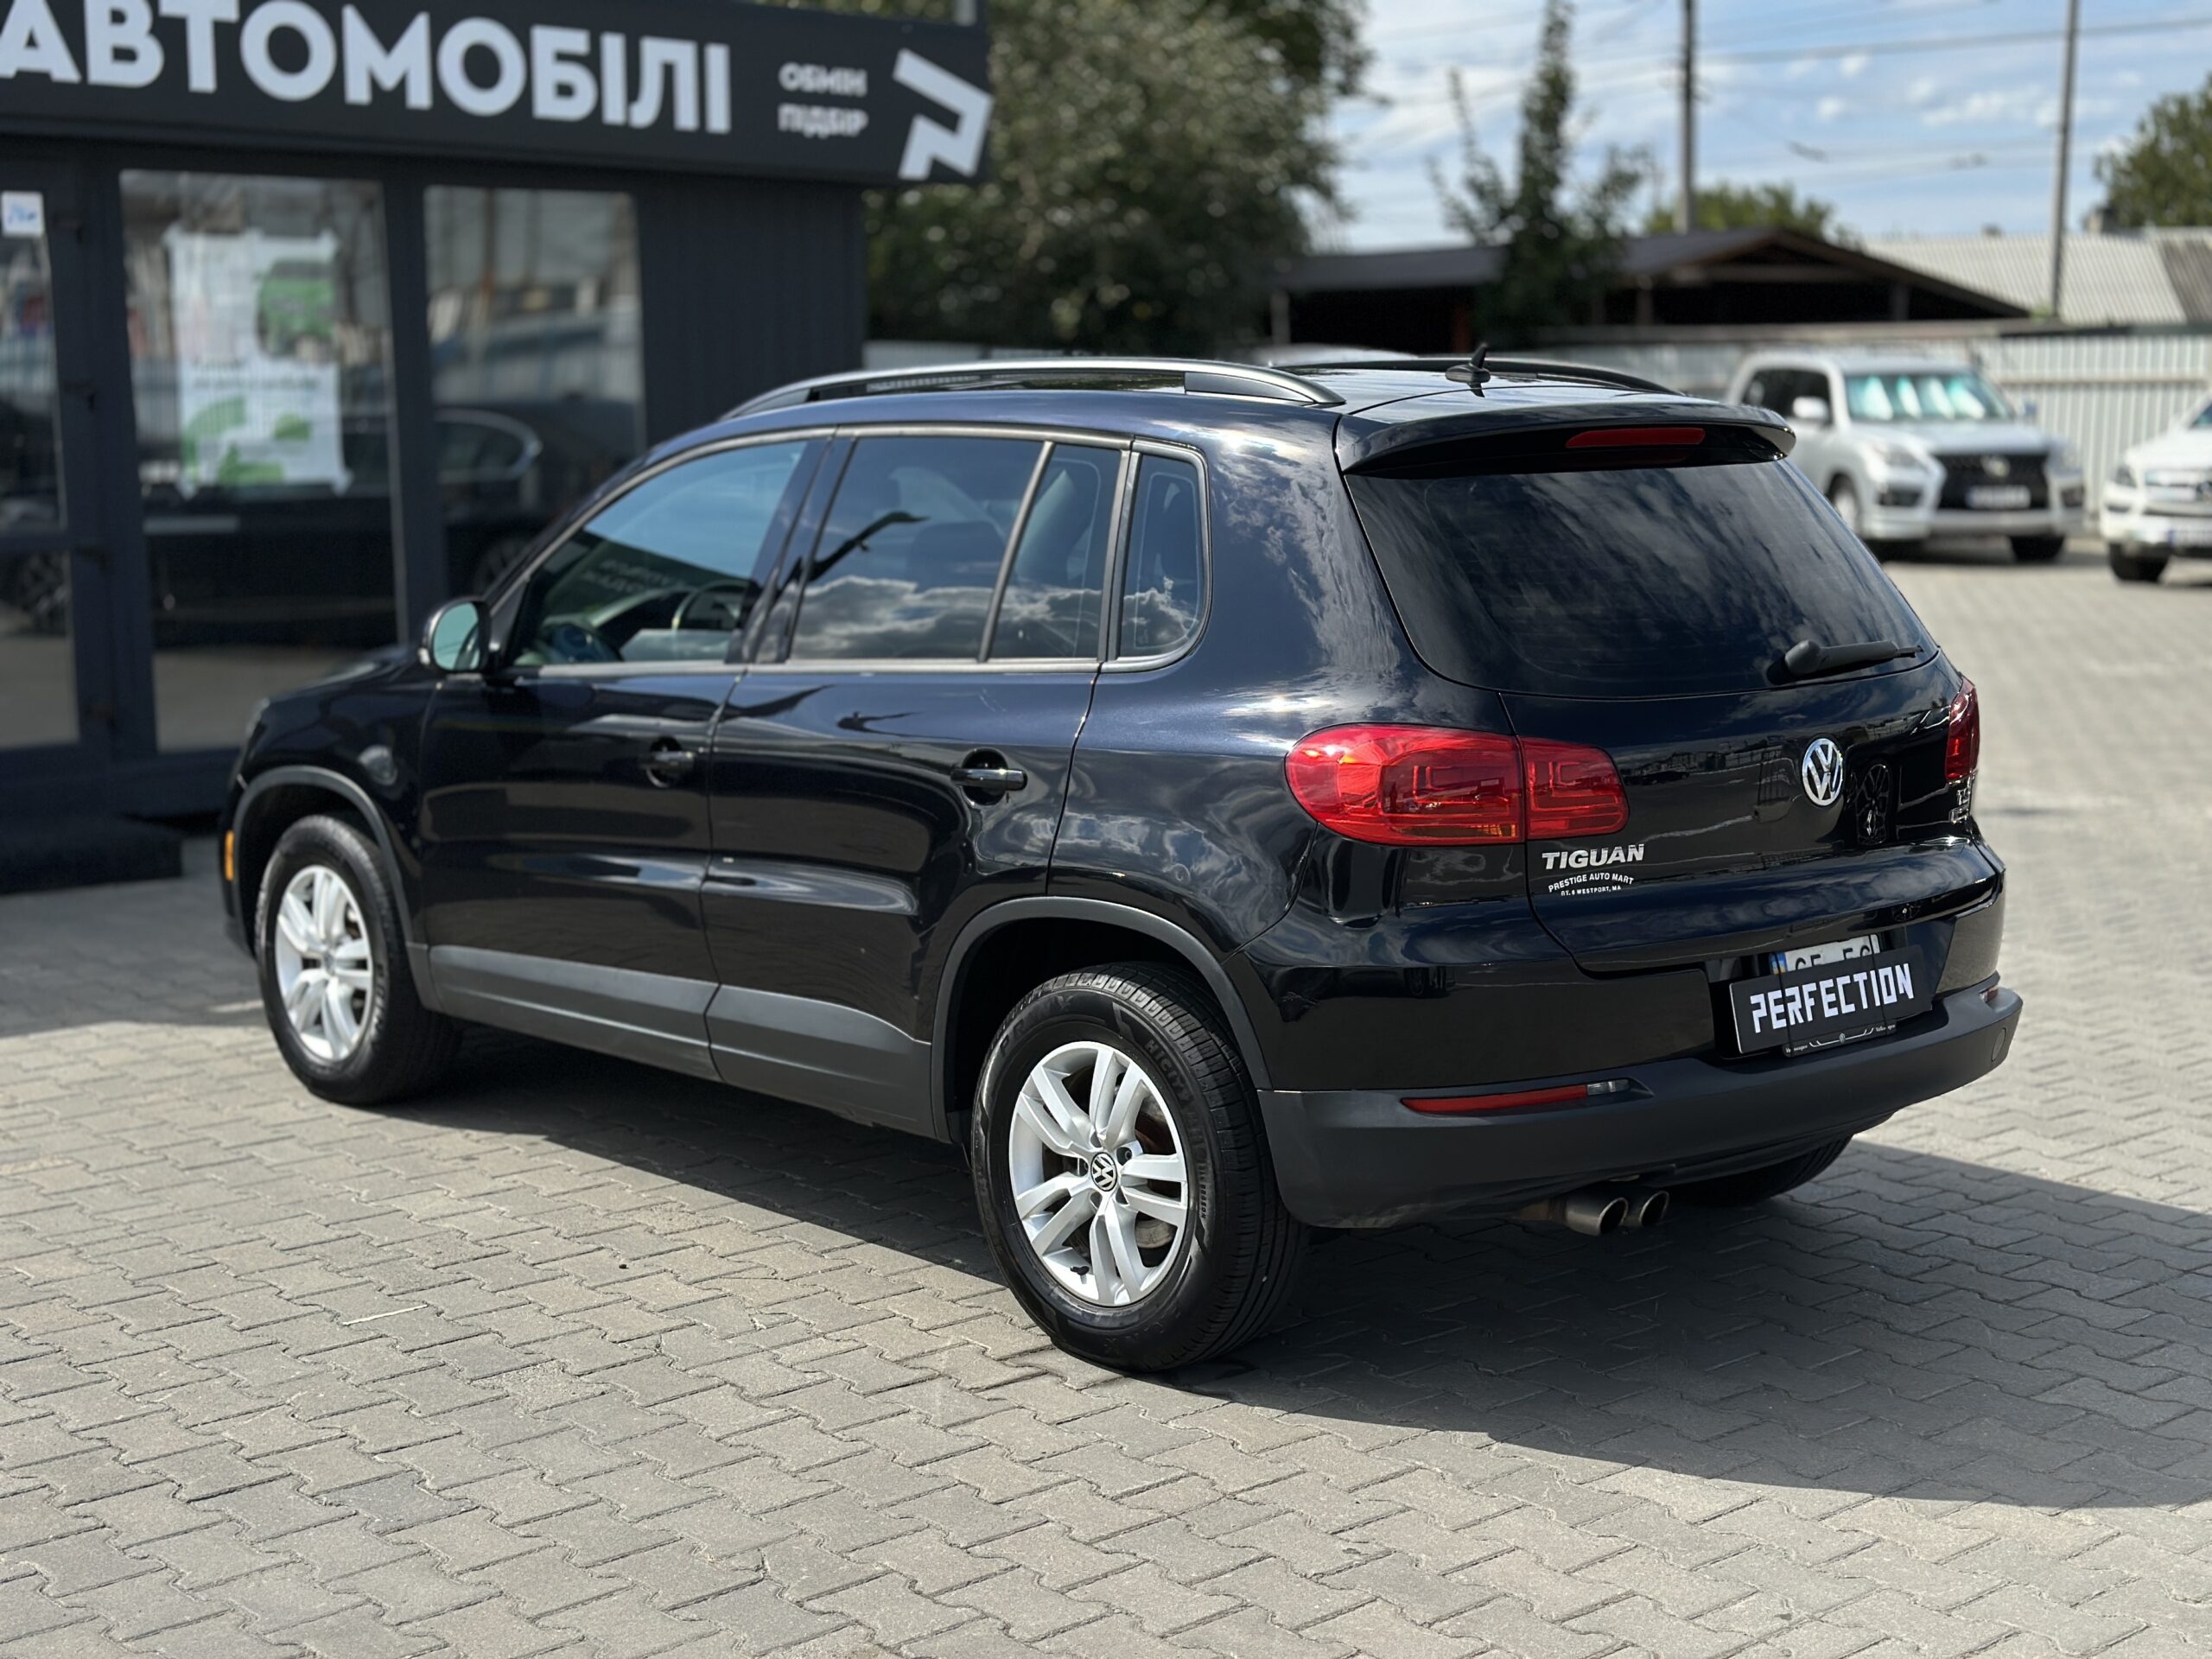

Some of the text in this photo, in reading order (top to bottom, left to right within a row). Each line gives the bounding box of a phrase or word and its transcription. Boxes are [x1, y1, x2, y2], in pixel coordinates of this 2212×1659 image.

[0, 0, 730, 133] АВТОМОБІЛІ
[1541, 844, 1644, 870] TIGUAN
[1548, 874, 1587, 893] PRESTIGE
[1611, 873, 1634, 885] MART
[1576, 886, 1611, 894] WESTPORT,
[1750, 963, 1915, 1033] PERFECTION
